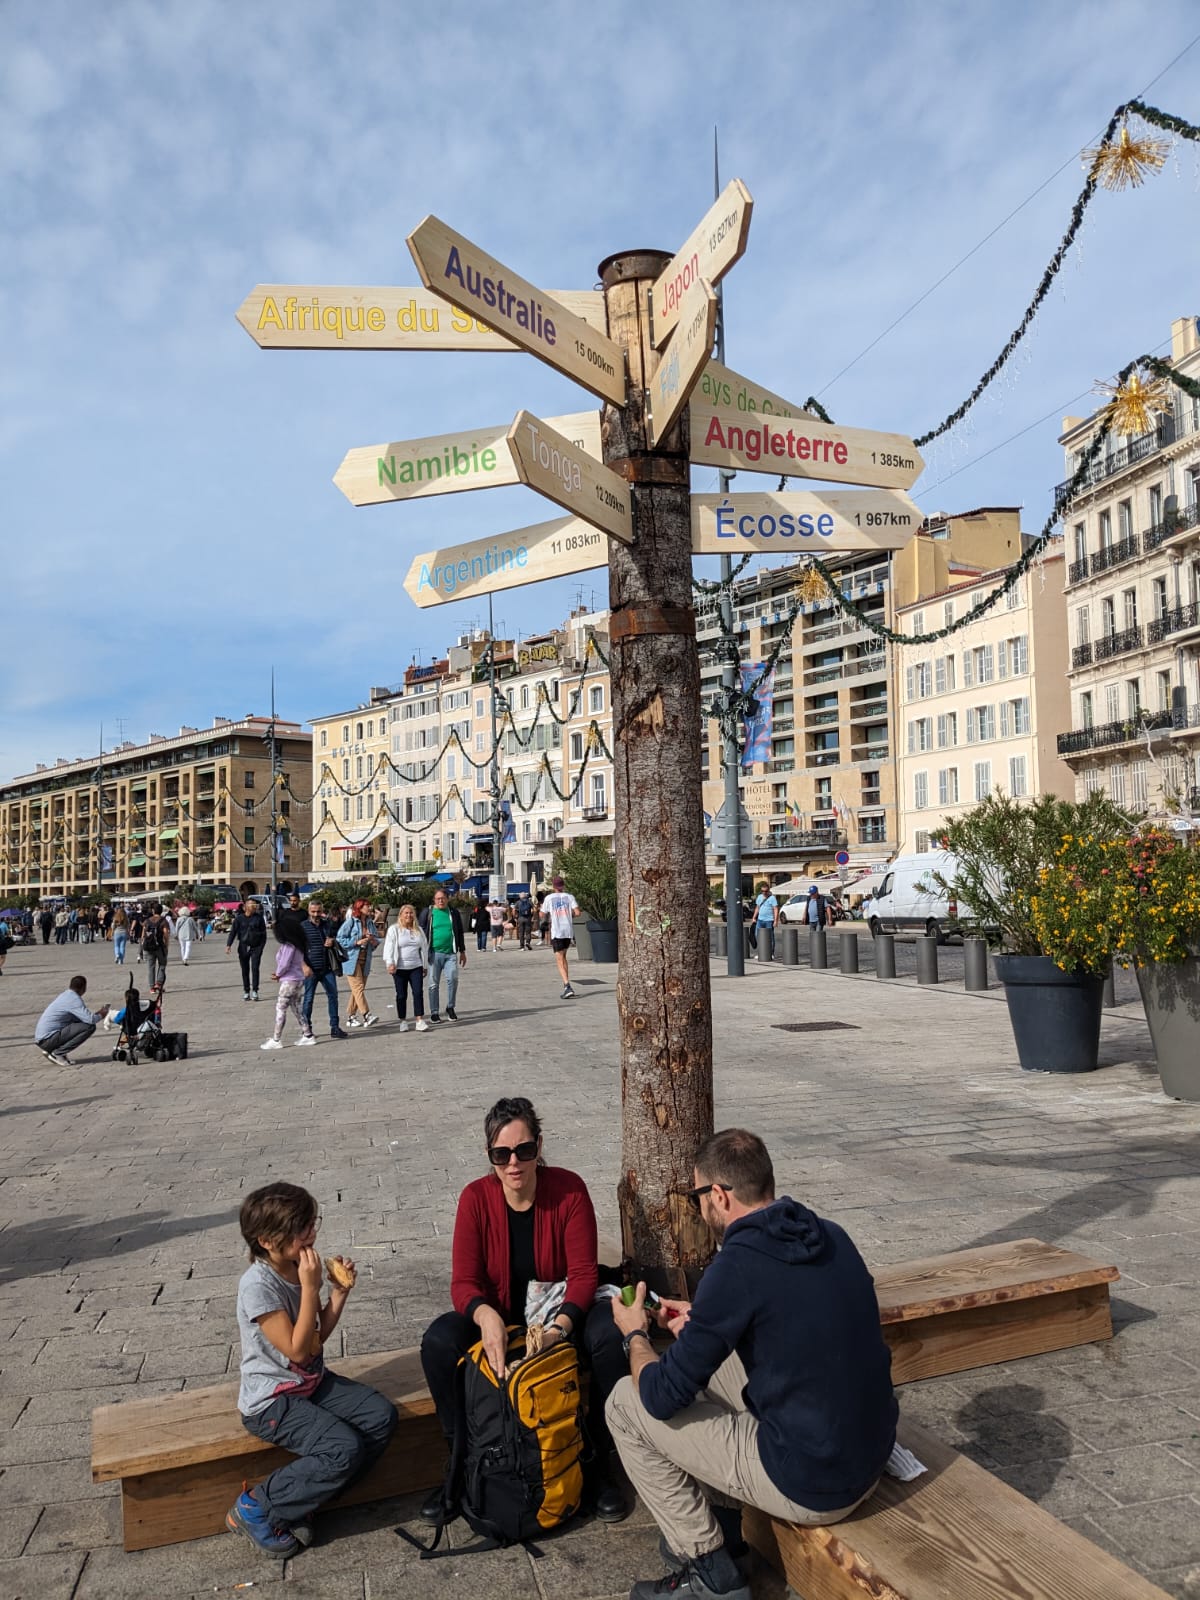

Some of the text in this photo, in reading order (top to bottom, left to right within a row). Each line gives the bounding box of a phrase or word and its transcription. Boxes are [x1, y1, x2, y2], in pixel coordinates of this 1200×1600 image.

[662, 210, 738, 317] Japon 13 627km
[257, 296, 386, 339] Afrique
[397, 299, 440, 332] du
[444, 245, 615, 377] Australie 15 000km
[702, 373, 731, 407] ays
[737, 387, 757, 413] de
[377, 442, 497, 487] Namibie
[704, 416, 915, 470] Angleterre 1 385km
[527, 423, 583, 494] Tonga
[596, 485, 604, 502] 12
[605, 490, 625, 516] 209km
[716, 500, 911, 539] Écosse 1 967km
[417, 532, 601, 593] Argentine 11 083km
[332, 743, 367, 758] HOTEL
[746, 784, 771, 795] HOTEL
